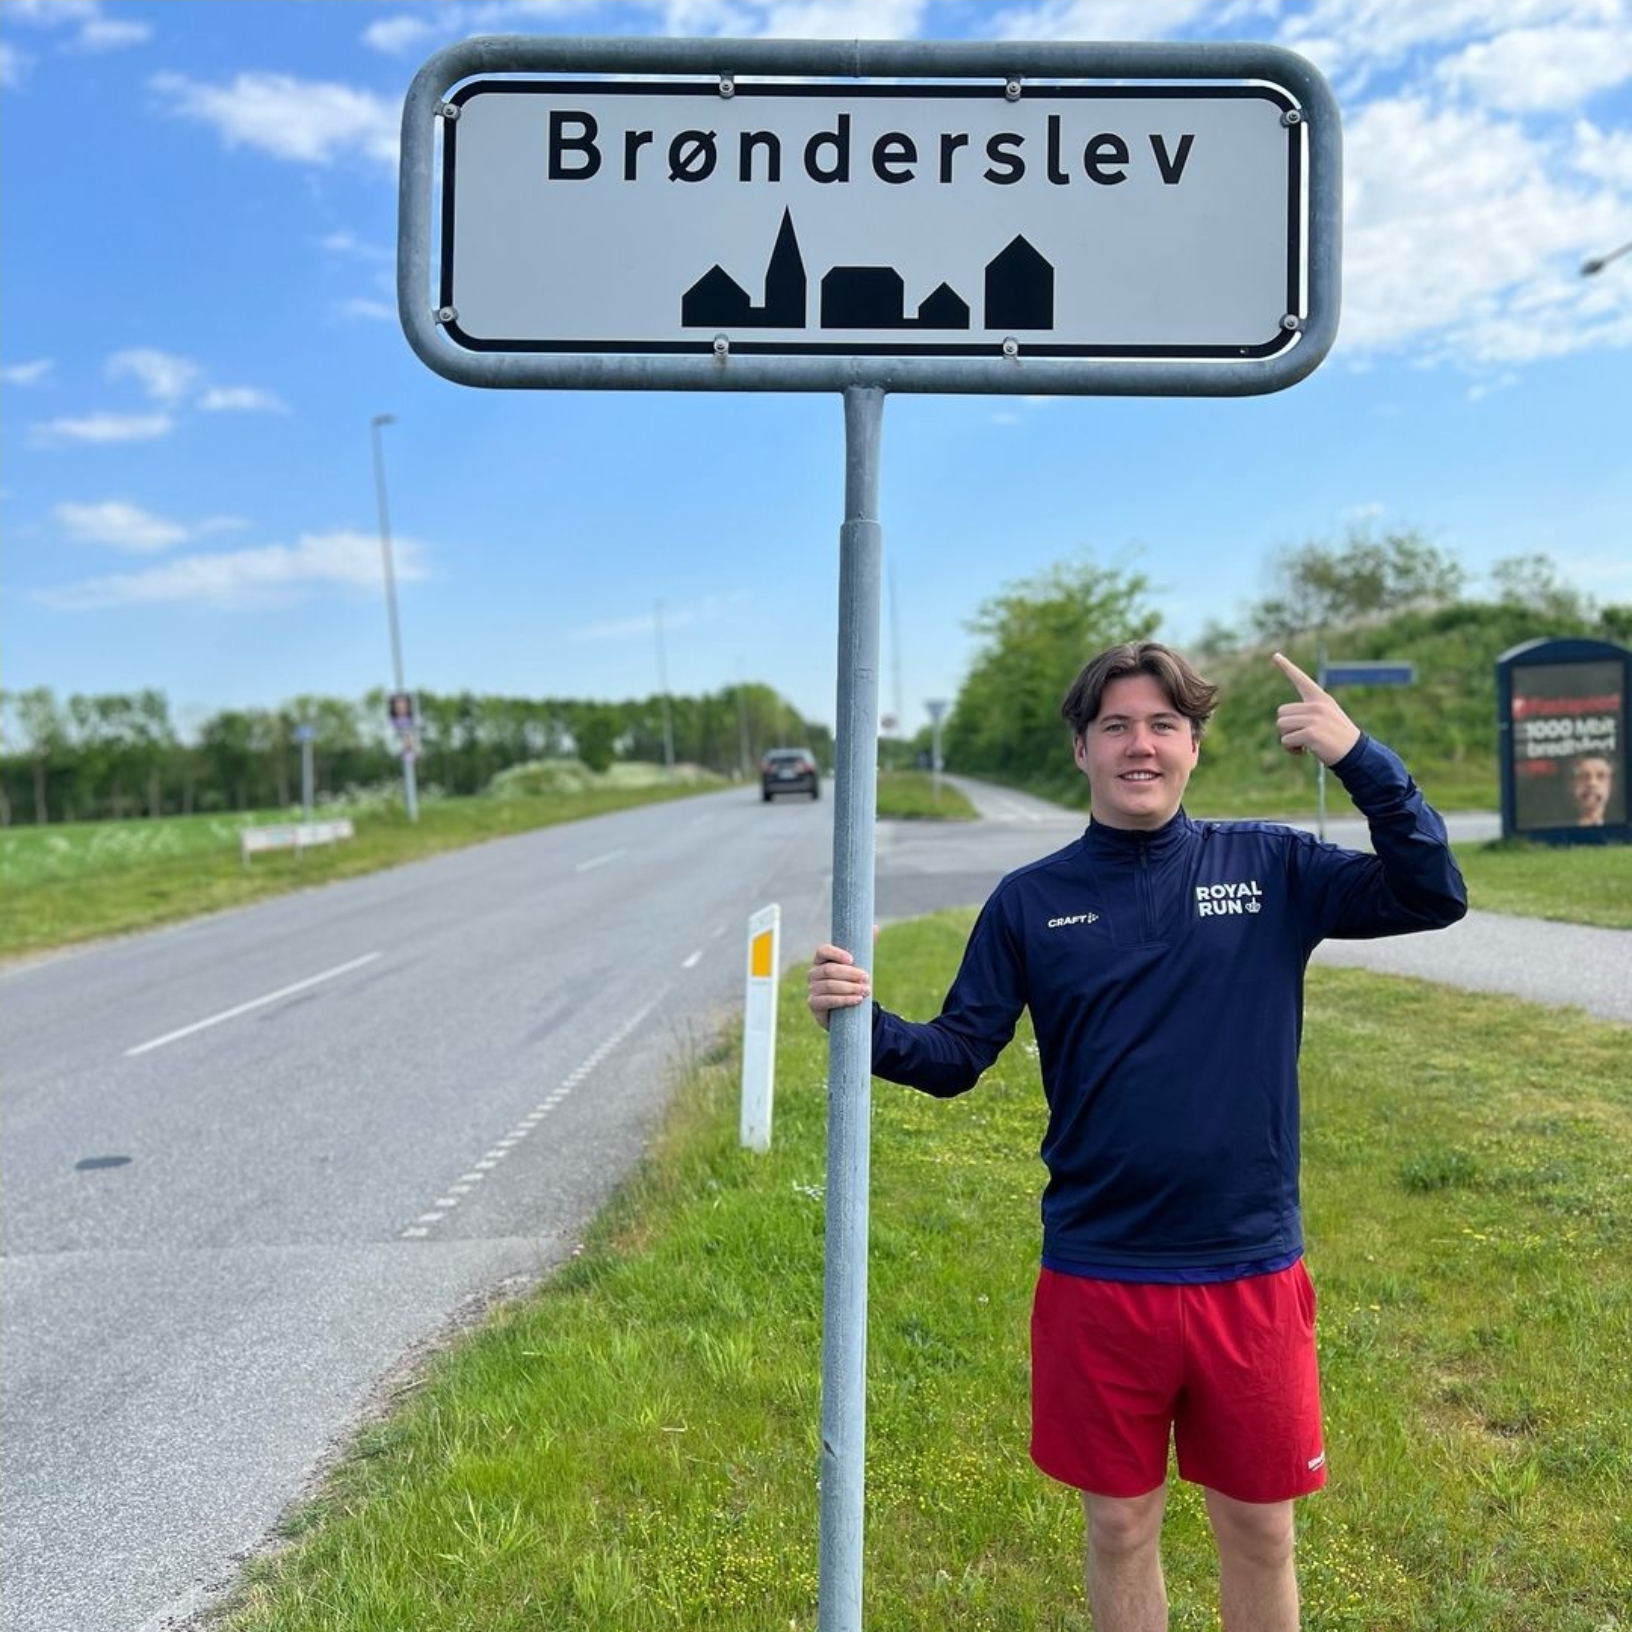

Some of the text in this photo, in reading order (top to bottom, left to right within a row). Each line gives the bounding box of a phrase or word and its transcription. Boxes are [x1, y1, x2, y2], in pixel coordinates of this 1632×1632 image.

[547, 110, 1196, 186] Brønderslev
[1196, 880, 1263, 901] ROYAL
[1198, 899, 1243, 917] RUN
[1048, 915, 1087, 928] CRAFT
